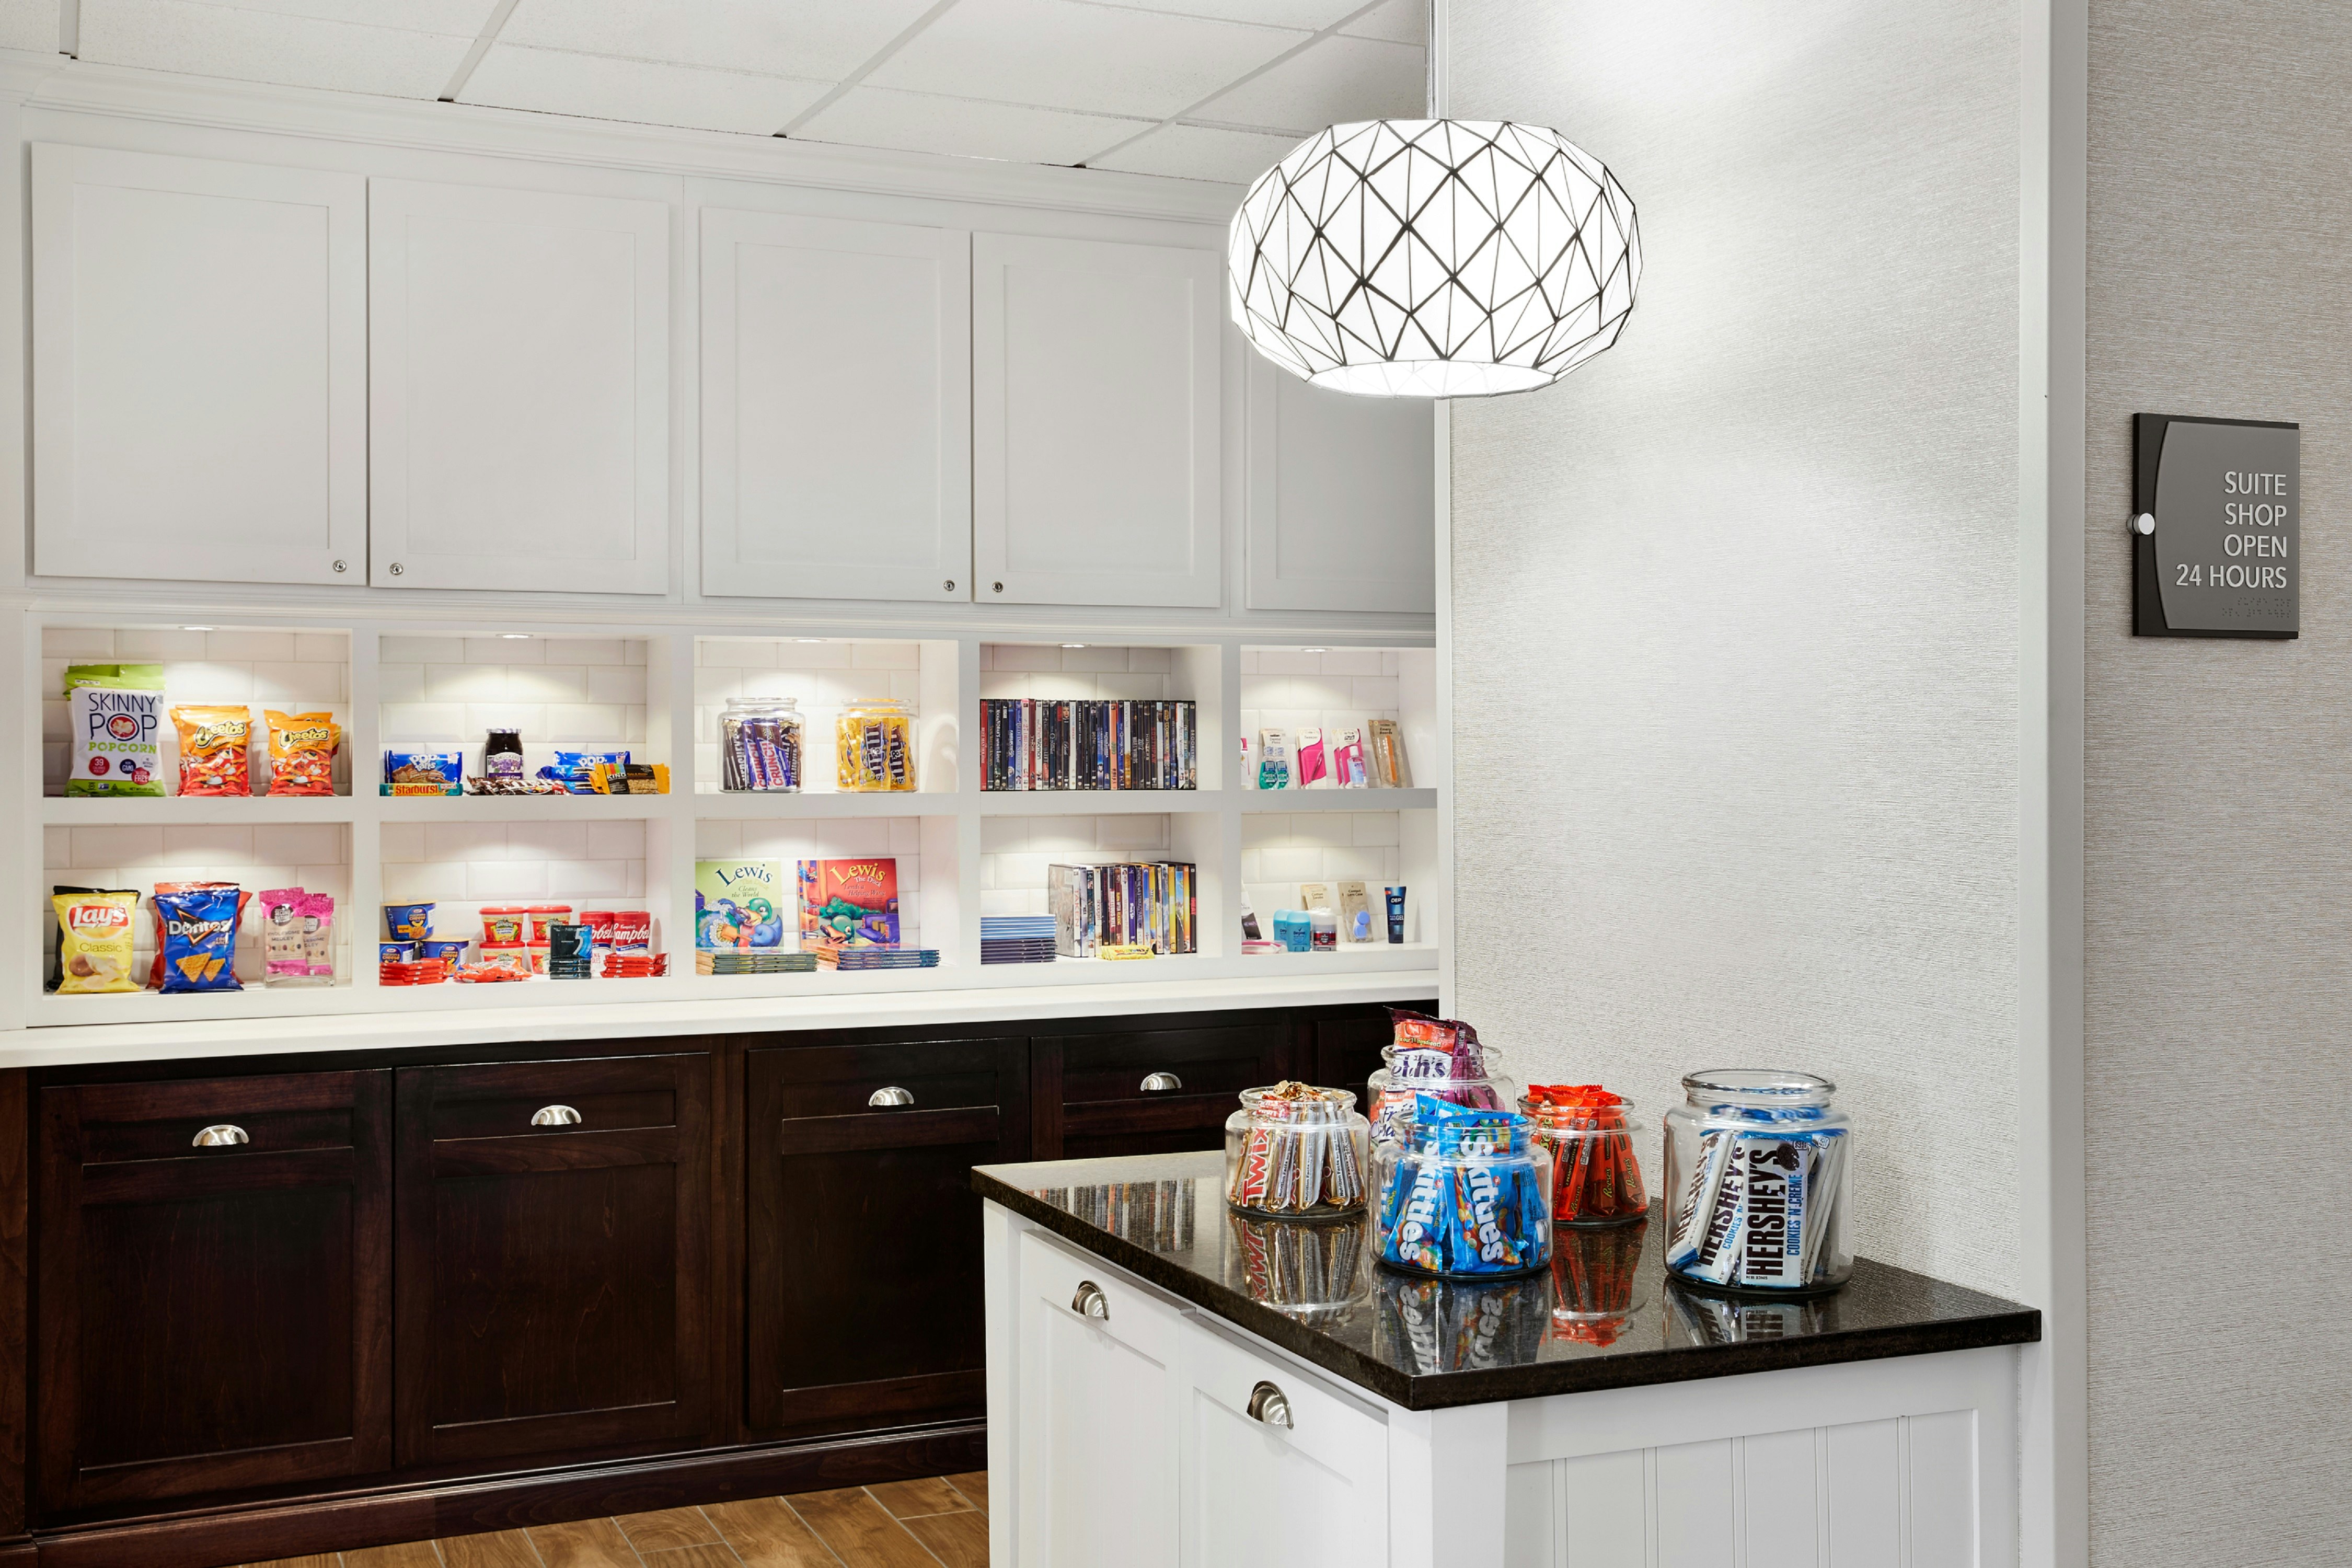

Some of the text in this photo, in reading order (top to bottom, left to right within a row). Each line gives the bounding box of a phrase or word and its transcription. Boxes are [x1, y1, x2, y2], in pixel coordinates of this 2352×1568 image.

[2223, 471, 2287, 495] SUITE
[2224, 502, 2287, 526] SHOP
[2224, 534, 2287, 557] OPEN
[2176, 563, 2287, 589] 24 HOURS
[88, 691, 156, 713] SKINNY
[89, 713, 157, 742] POP
[195, 721, 245, 747] Cheetos
[280, 729, 329, 748] Cheetos
[88, 742, 157, 754] POPCORN
[761, 742, 784, 786] CRUNCH
[715, 863, 773, 887] Lewis
[829, 863, 886, 885] Lewis
[867, 877, 882, 887] Duck
[168, 917, 234, 936] Doritos
[79, 942, 122, 953] Classic
[573, 928, 585, 955] 5
[1242, 1127, 1270, 1207] TWIX
[1624, 1157, 1637, 1188] Reese's
[1603, 1167, 1612, 1198] Reese's
[1788, 1174, 1803, 1207] CREME
[1399, 1140, 1439, 1261] Skittles
[1460, 1135, 1504, 1263] Skittles
[1746, 1150, 1786, 1276] HERSHEY'S
[1722, 1216, 1743, 1250] COOKIES
[1786, 1220, 1801, 1256] COOKIES
